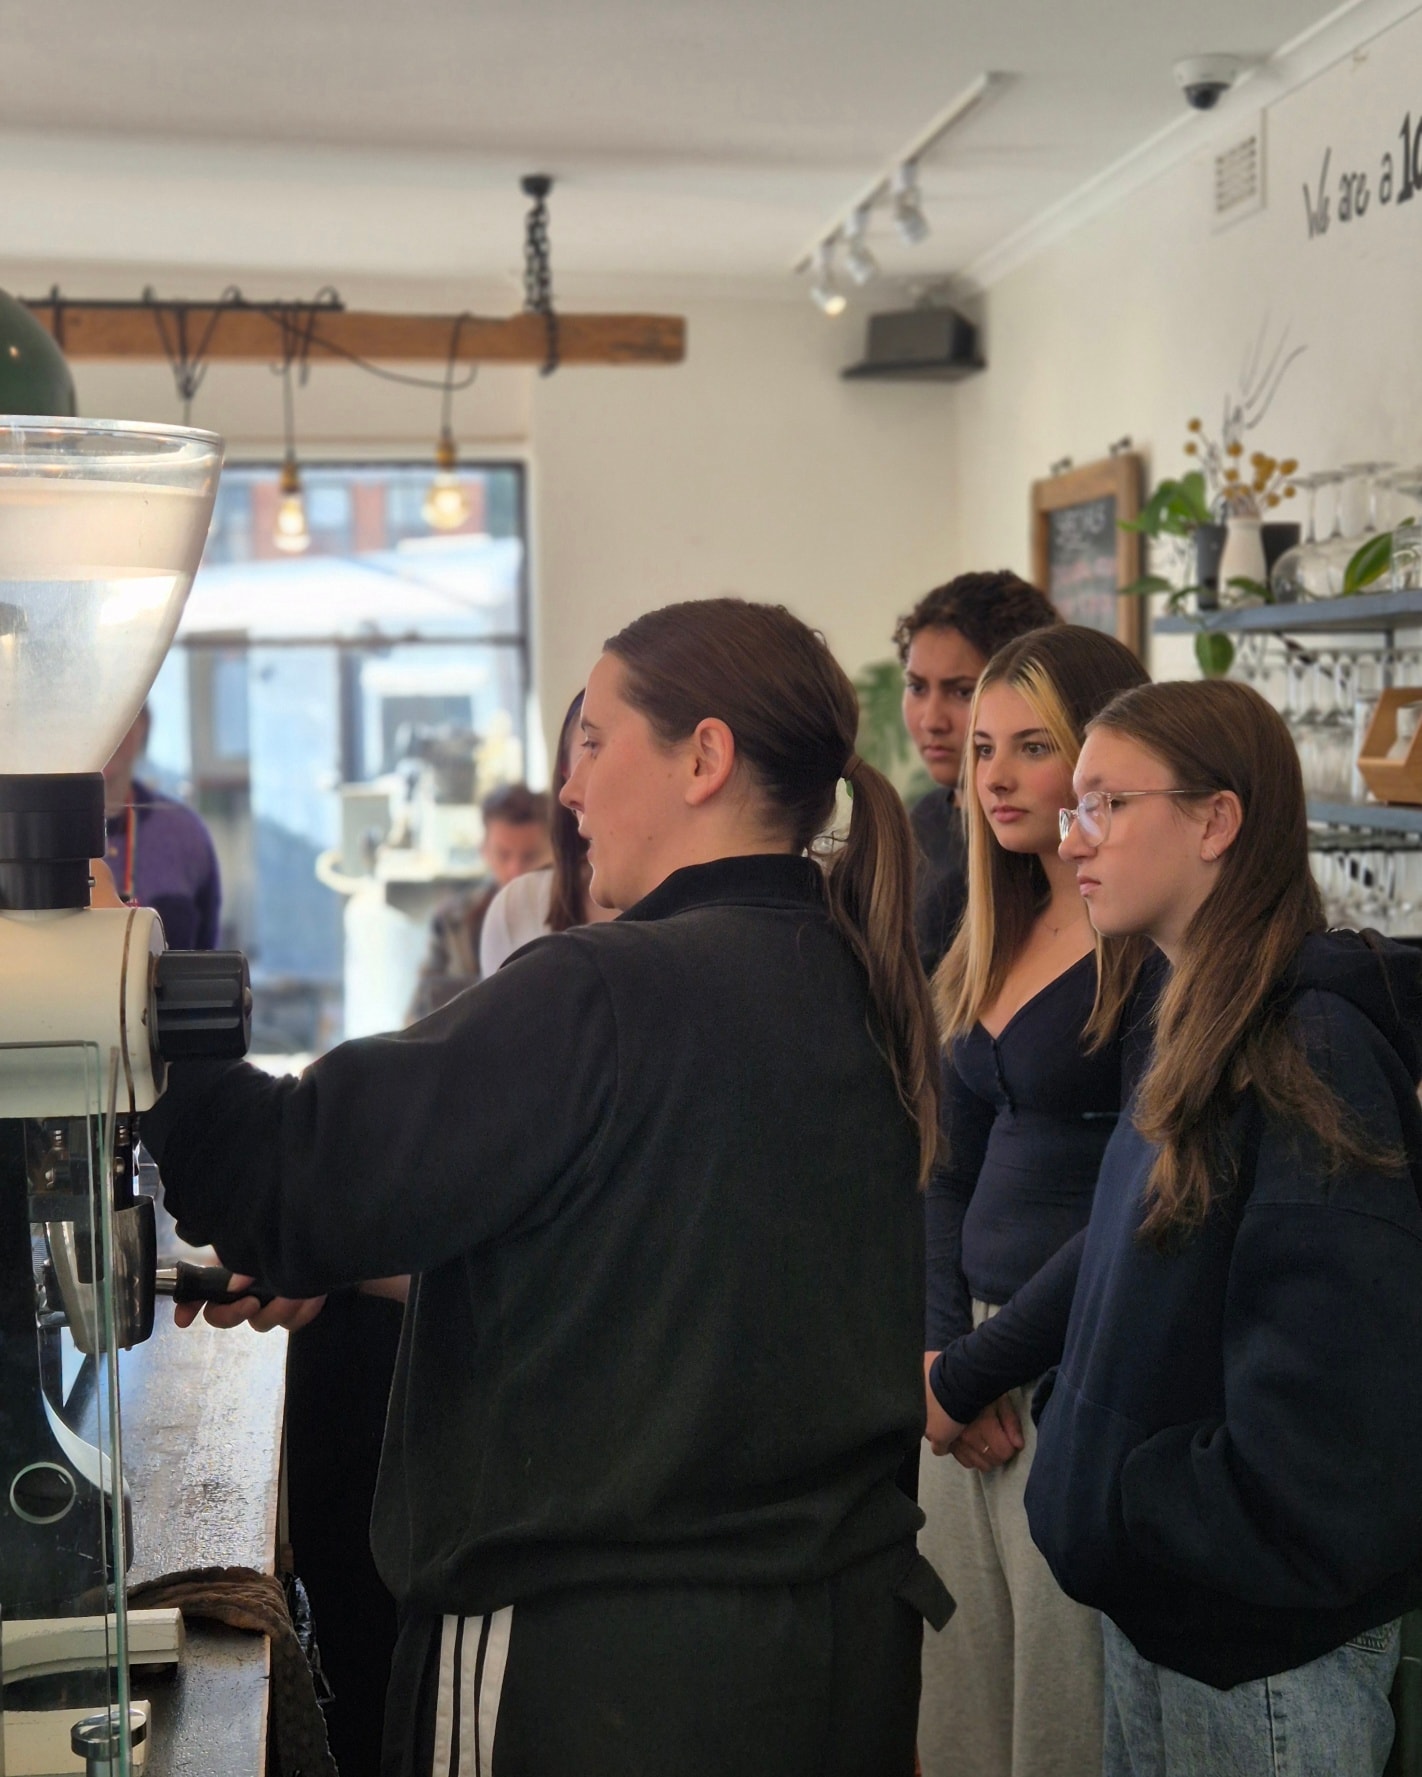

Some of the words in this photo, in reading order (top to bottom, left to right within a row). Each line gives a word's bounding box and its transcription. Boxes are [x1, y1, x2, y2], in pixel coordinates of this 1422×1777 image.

[1302, 146, 1331, 240] We
[1338, 171, 1371, 222] are
[1379, 151, 1393, 206] a
